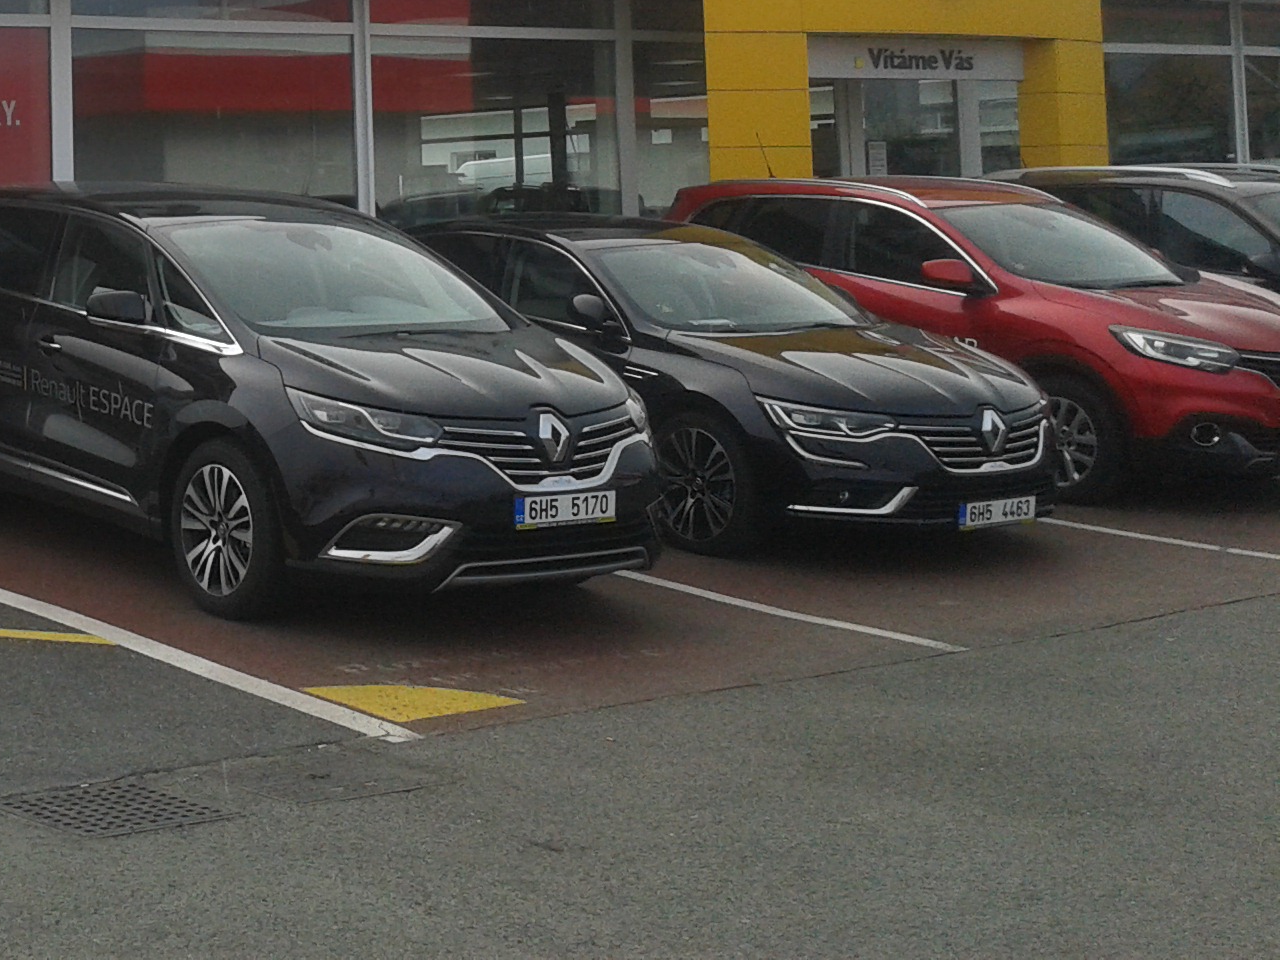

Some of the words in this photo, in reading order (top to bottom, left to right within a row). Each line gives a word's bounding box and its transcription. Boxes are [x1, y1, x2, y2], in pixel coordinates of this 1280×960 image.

[867, 47, 939, 71] Vítáme
[940, 49, 974, 71] Vás
[30, 368, 86, 408] Renault
[89, 386, 155, 429] ESPACE
[528, 498, 559, 521] 6H5
[571, 493, 609, 517] 5170
[969, 503, 993, 523] 6H5
[1001, 499, 1031, 519] 4463
